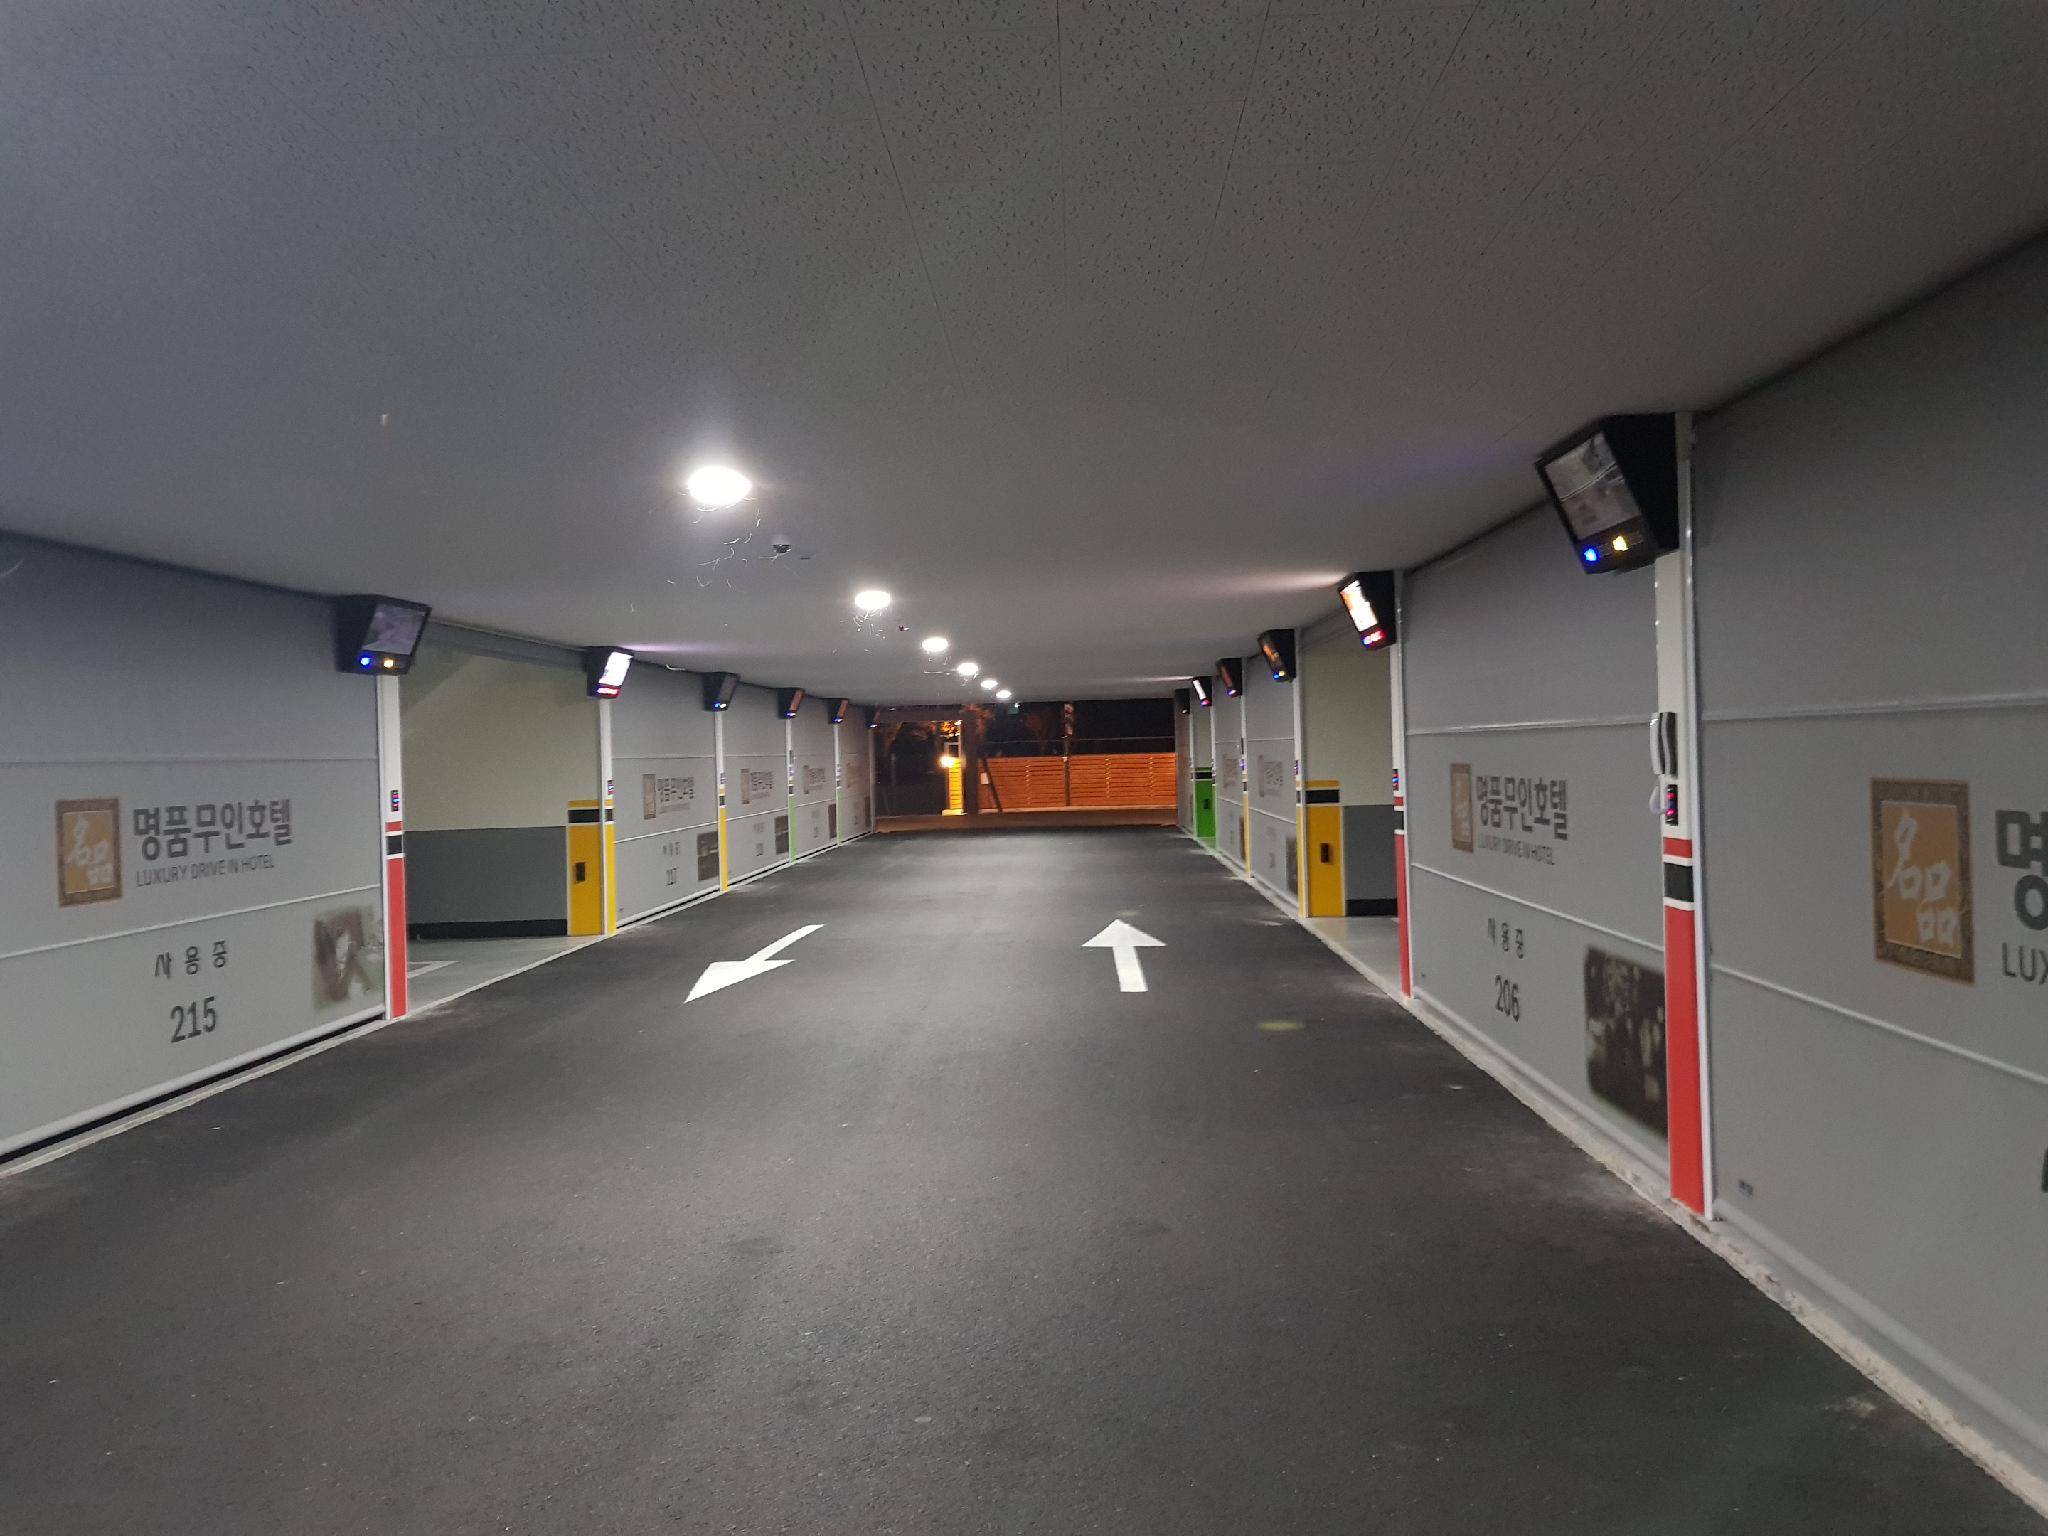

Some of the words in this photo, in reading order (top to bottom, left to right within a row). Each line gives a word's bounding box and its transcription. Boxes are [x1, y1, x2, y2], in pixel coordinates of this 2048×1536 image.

[133, 799, 292, 861] 명품무인호텔
[1475, 775, 1568, 840] 명품무인호텔
[136, 865, 187, 888] LUXURY
[190, 859, 225, 880] DRIVE
[227, 859, 239, 874] IN
[240, 854, 275, 873] HOTEL
[170, 996, 217, 1043] 215
[1495, 974, 1520, 1023] 206
